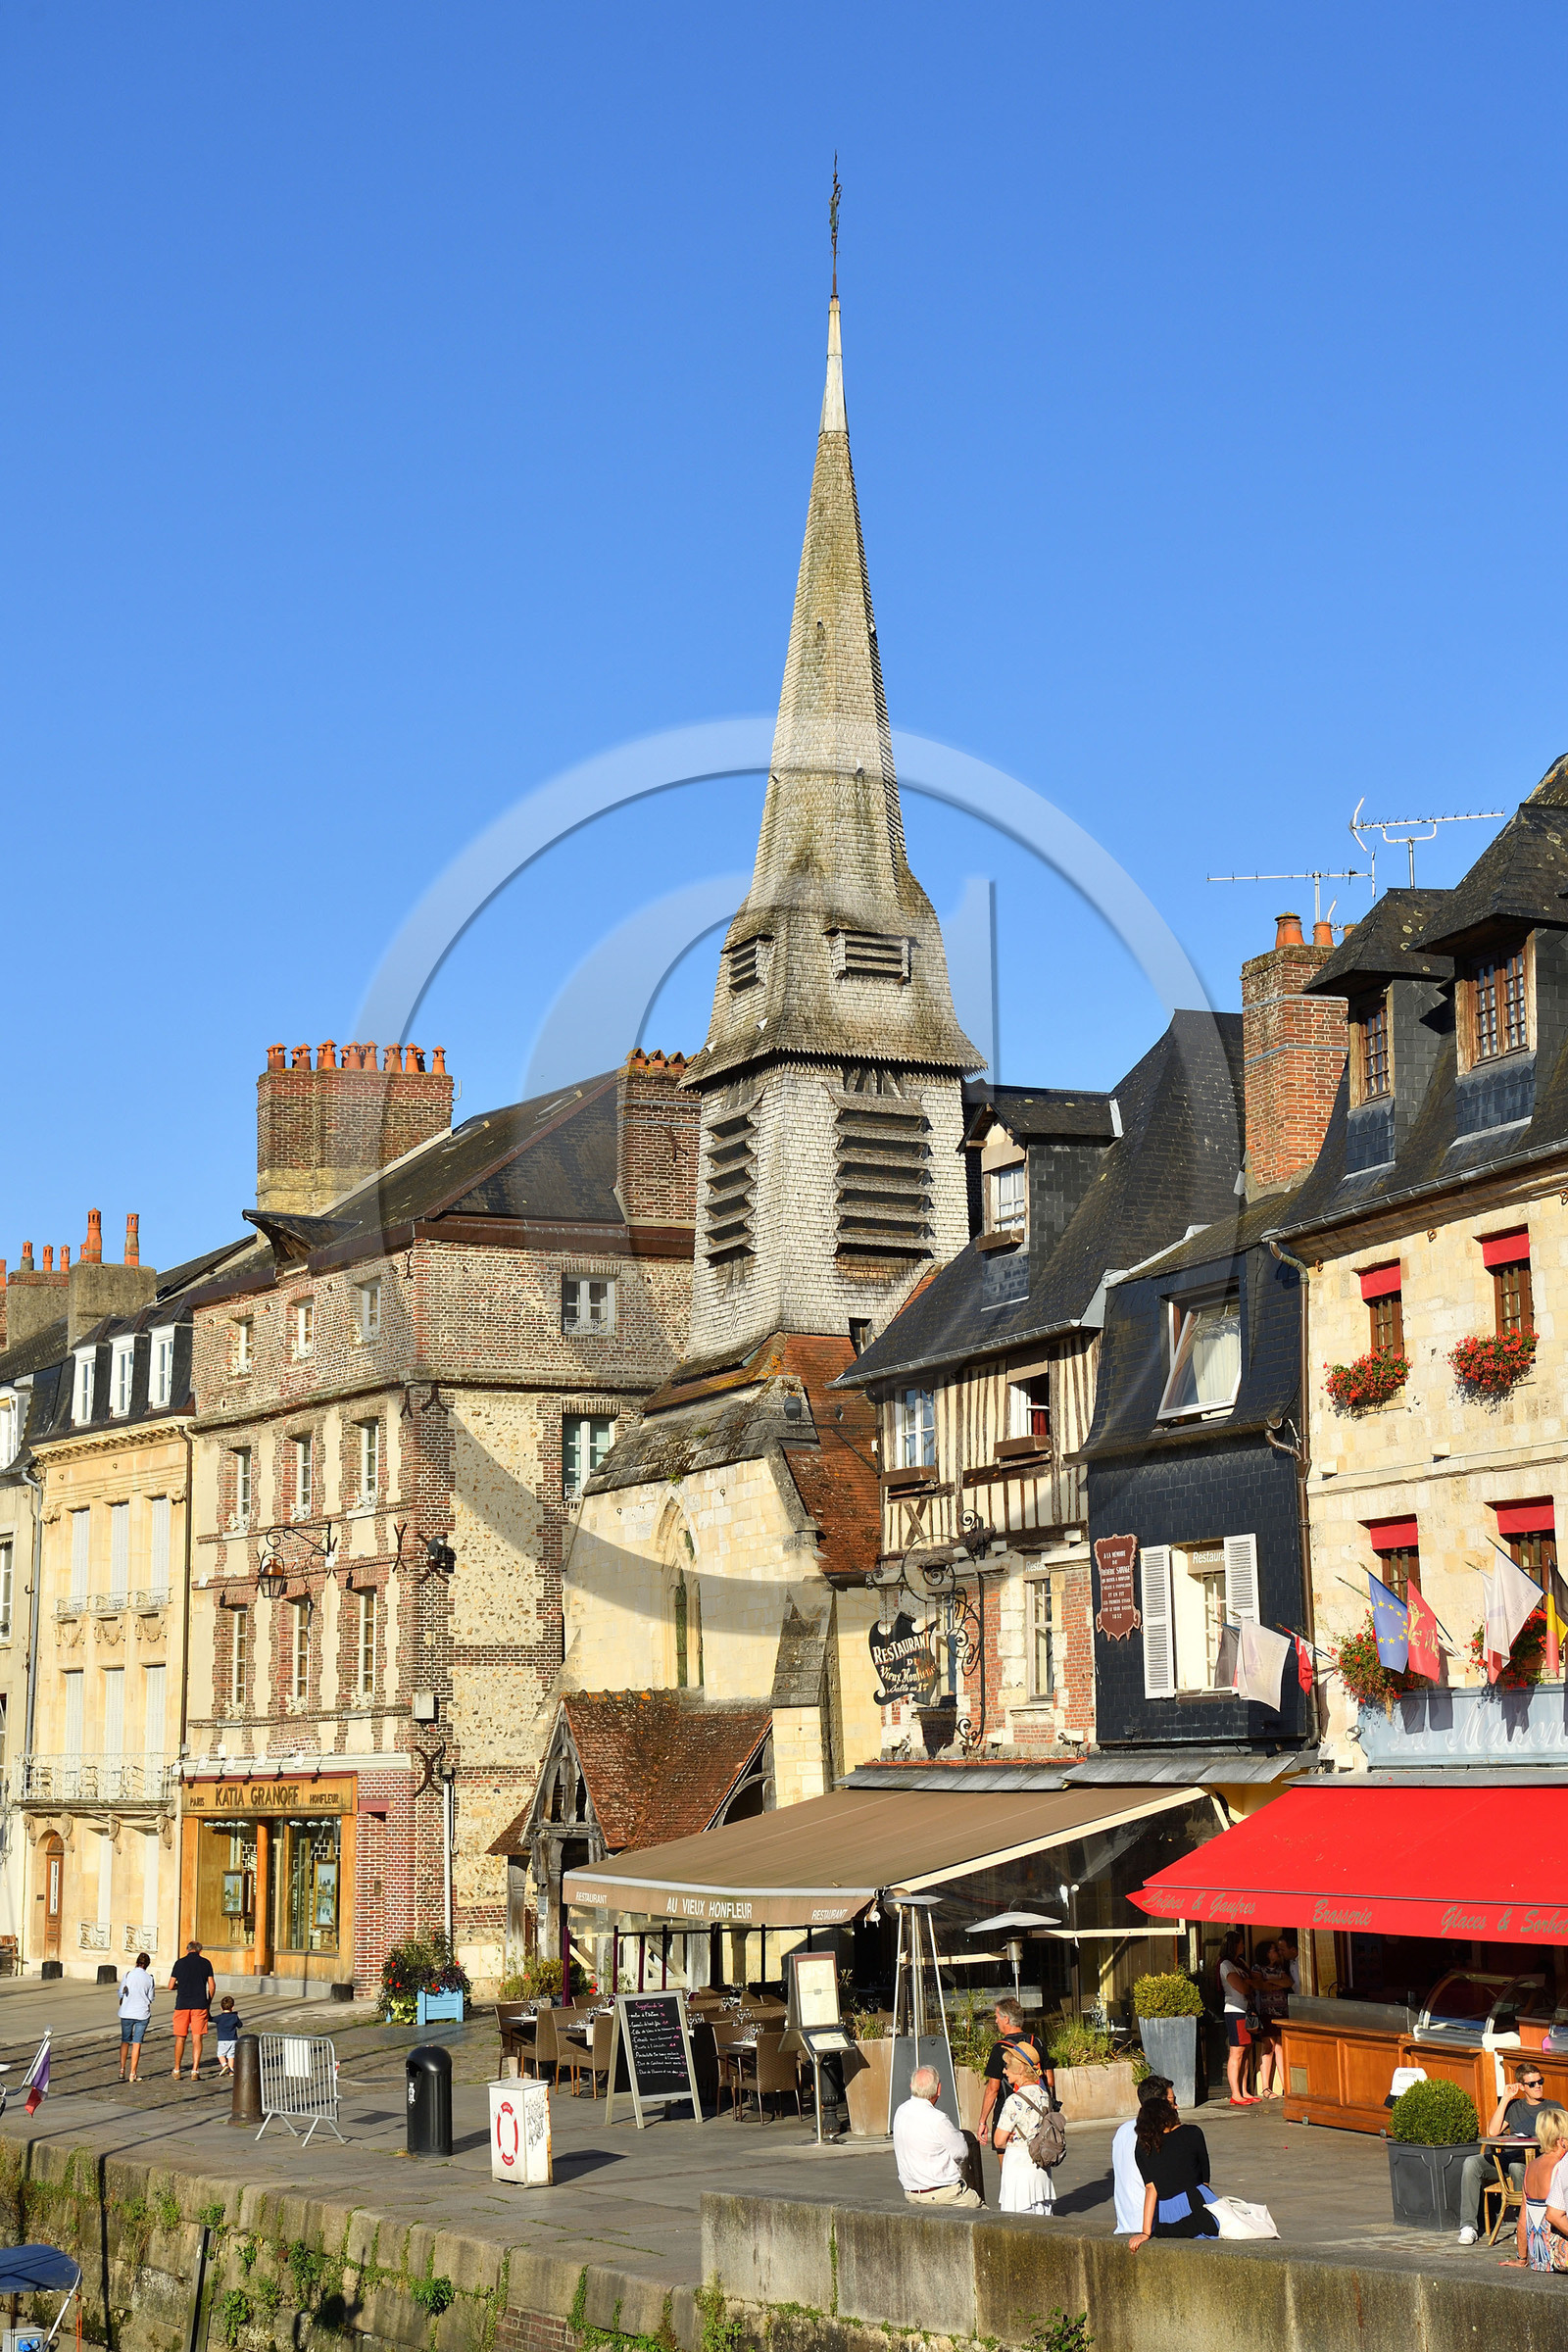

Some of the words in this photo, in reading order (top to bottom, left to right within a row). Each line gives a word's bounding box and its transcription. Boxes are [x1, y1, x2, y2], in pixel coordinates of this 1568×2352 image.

[1192, 1551, 1225, 1564] Restaura
[190, 1796, 205, 1807] PARIS
[215, 1787, 245, 1807] KATIA
[250, 1785, 300, 1806] GRANOFF
[309, 1792, 339, 1805] HONFLEUR
[575, 1891, 608, 1905] RESTAURANT
[666, 1897, 678, 1914] AU
[682, 1898, 706, 1916] VIEUX
[709, 1901, 753, 1919] HONFLEUR
[811, 1908, 848, 1921] RESTAURANT
[1191, 1892, 1206, 1911] &
[1208, 1892, 1256, 1920] Gaufres
[1312, 1899, 1373, 1927] Brasserie
[1441, 1905, 1487, 1936] Glaces
[1497, 1908, 1513, 1932] &
